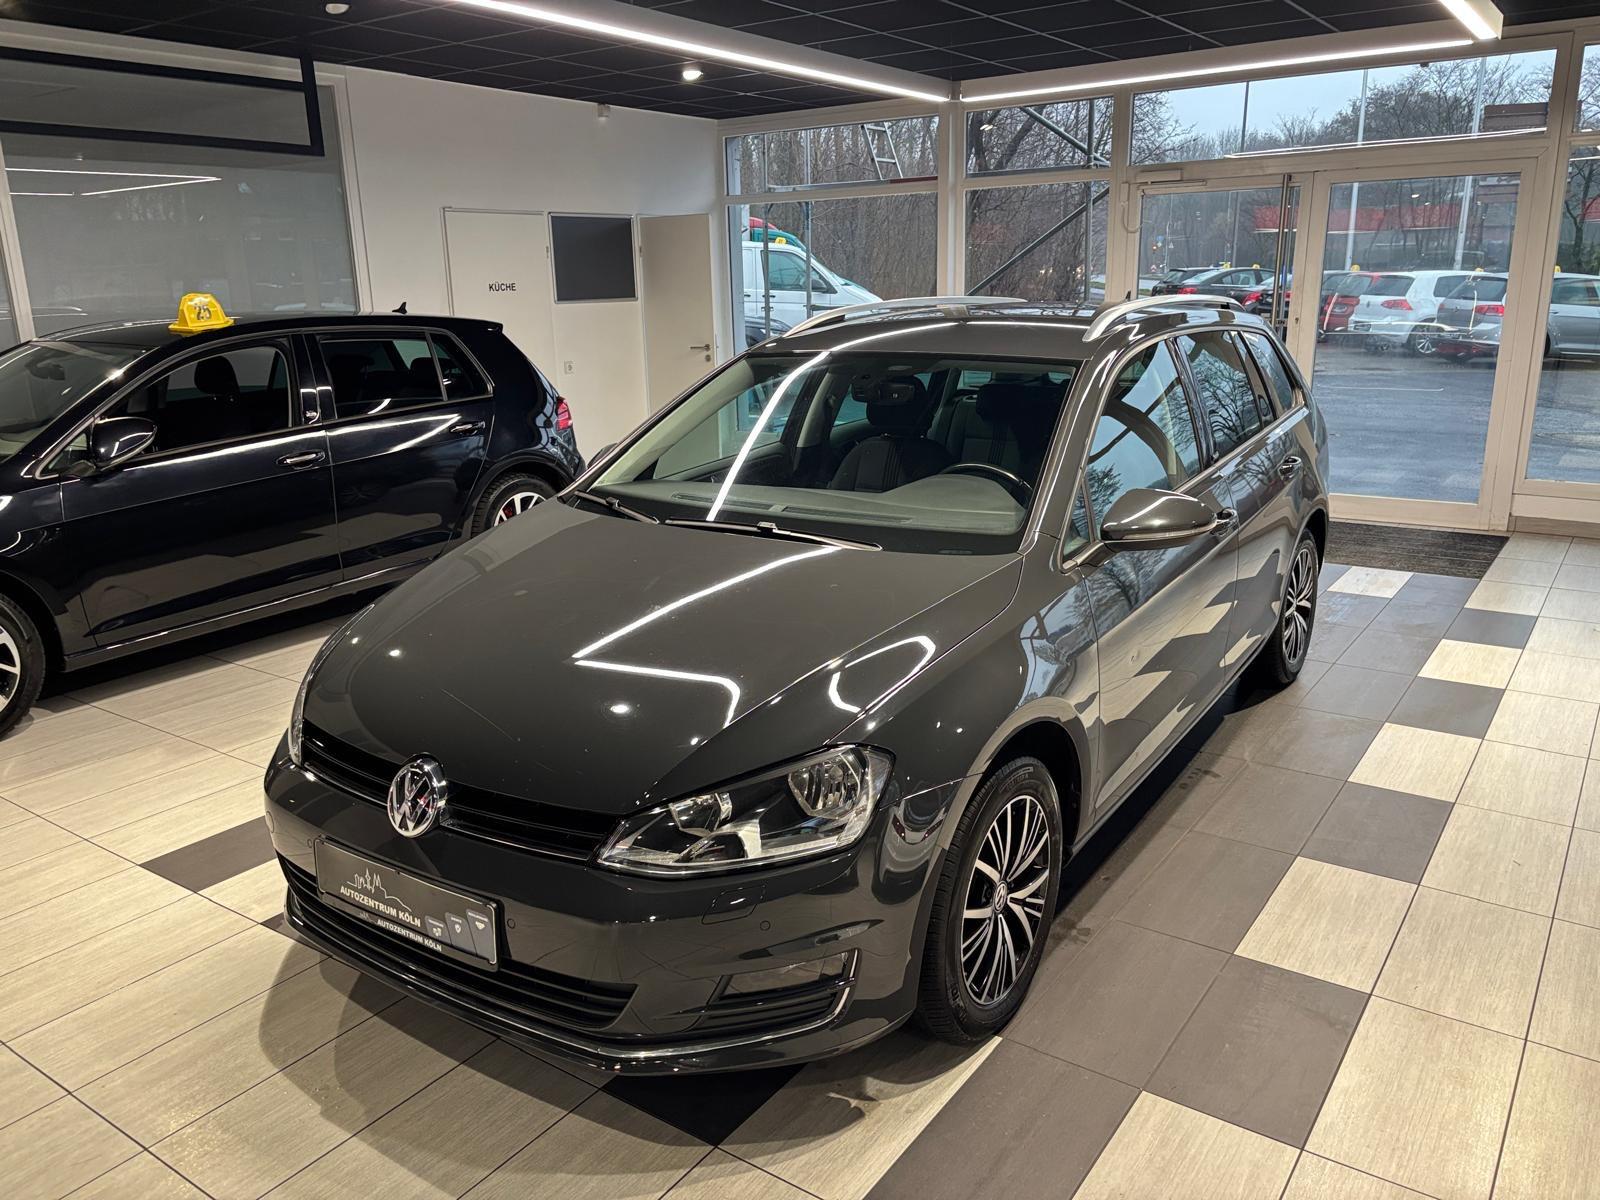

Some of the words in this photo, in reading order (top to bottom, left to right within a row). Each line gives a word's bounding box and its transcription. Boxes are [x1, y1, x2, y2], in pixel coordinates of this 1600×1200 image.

[488, 281, 517, 292] KÜCHE
[340, 885, 397, 918] AUTOZENTRUM
[398, 910, 421, 928] KÖLN
[376, 919, 423, 944] AUTOZENTRUM
[424, 937, 442, 953] KÖLN
